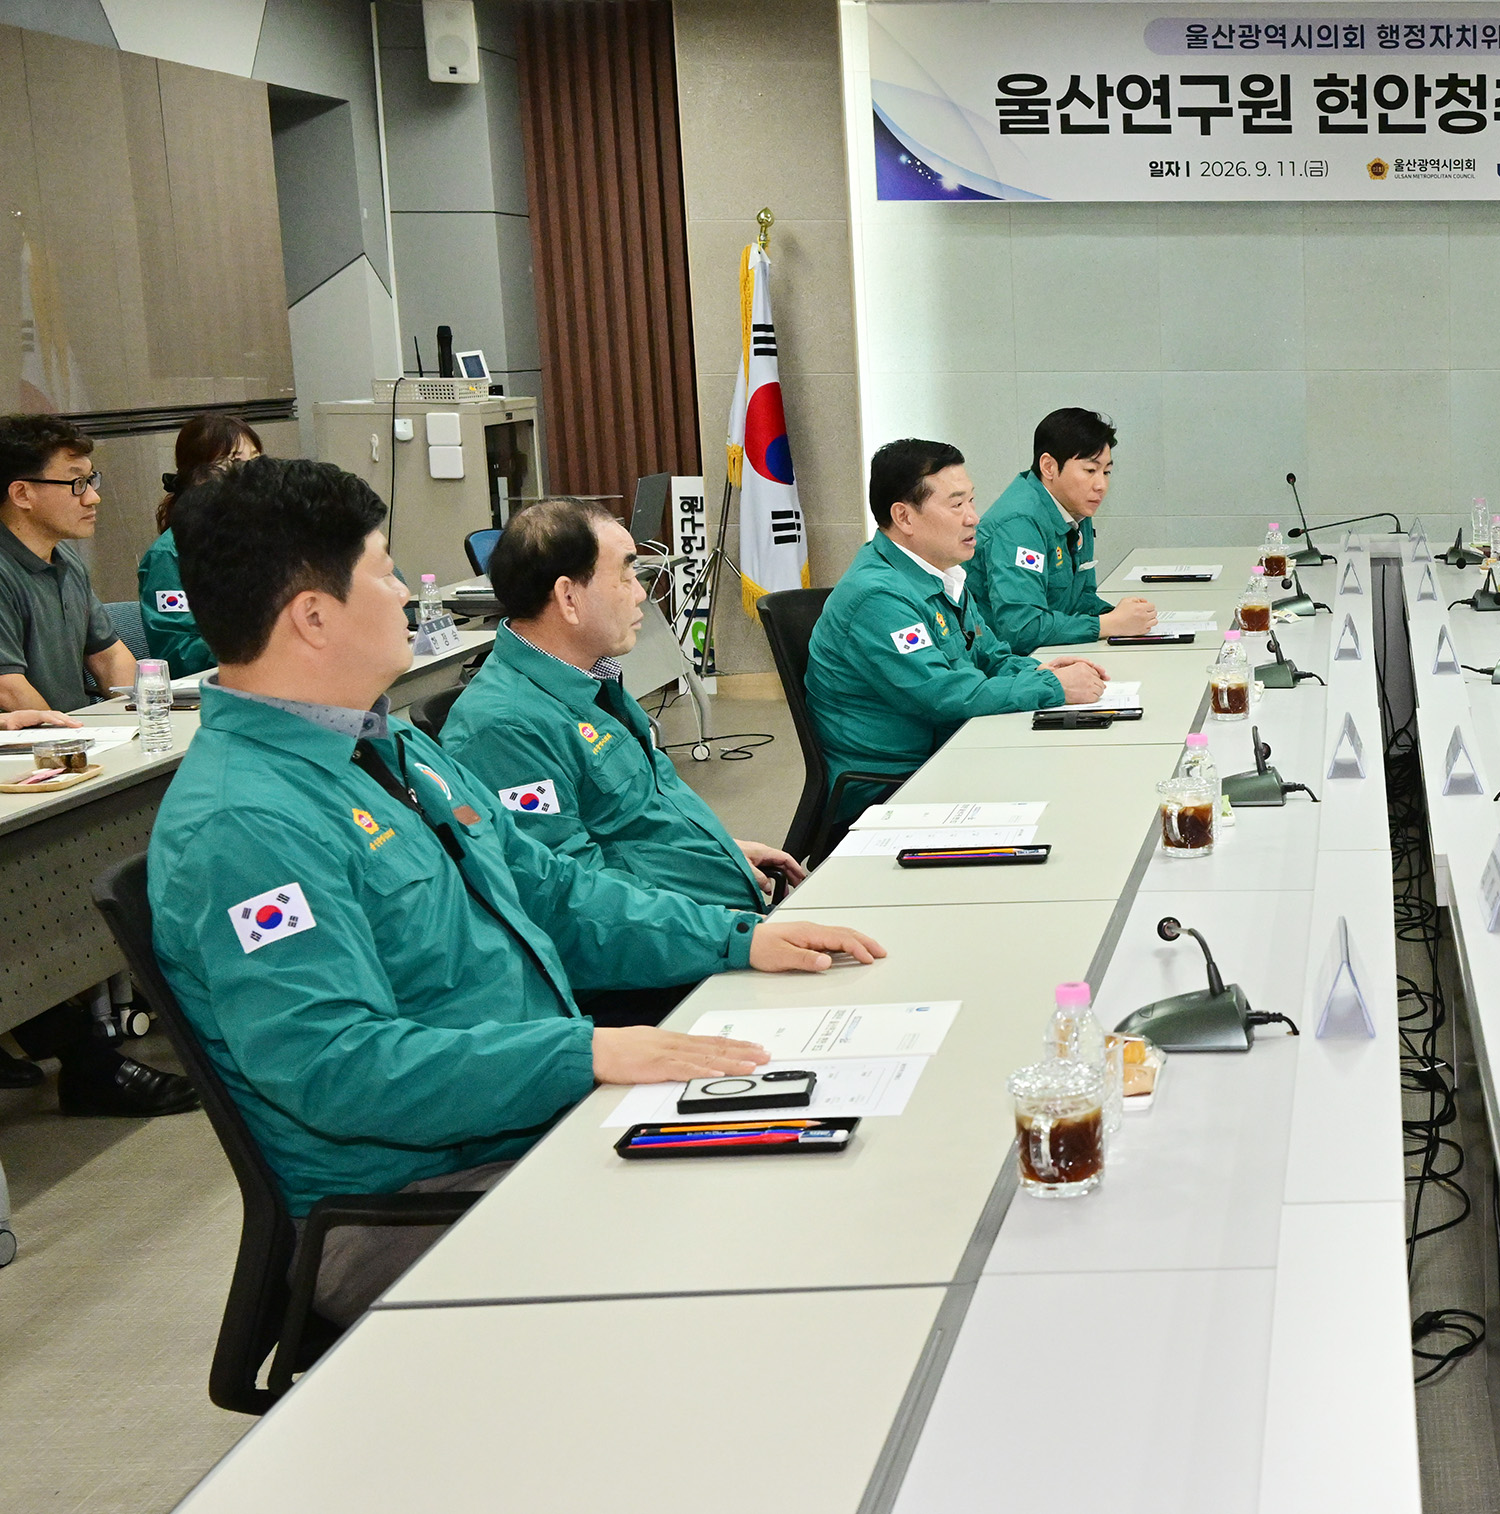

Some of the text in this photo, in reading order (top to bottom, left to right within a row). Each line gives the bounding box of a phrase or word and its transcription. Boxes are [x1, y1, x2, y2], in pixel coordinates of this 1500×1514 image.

[1185, 23, 1366, 50] 울산광역시의회
[995, 73, 1293, 136] 울산연구원
[1394, 158, 1476, 172] 울산광역시의회
